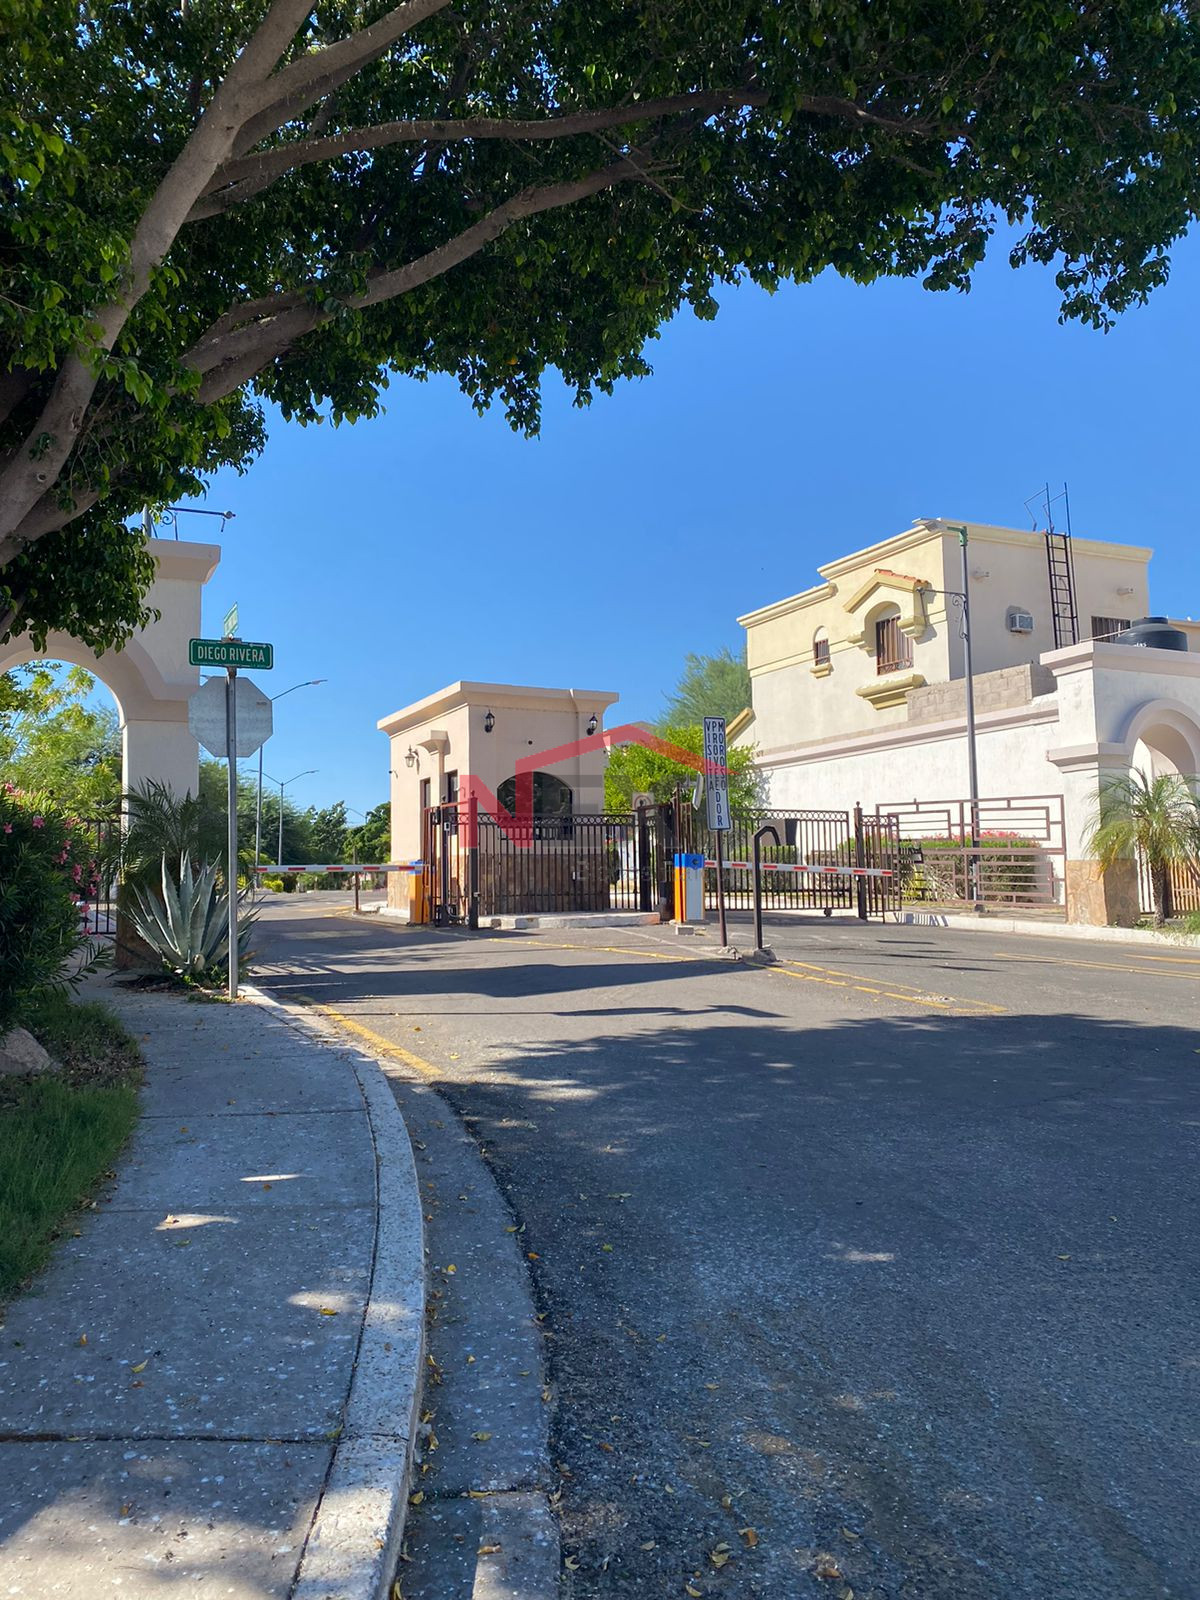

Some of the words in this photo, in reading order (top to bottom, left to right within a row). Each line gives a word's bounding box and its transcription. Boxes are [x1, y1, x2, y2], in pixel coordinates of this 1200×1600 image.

[198, 646, 227, 661] DIEGO
[229, 648, 265, 662] RIVERA
[706, 721, 715, 791] VISITA
[712, 721, 723, 826] PROVEEDOR
[718, 721, 726, 790] MOROSO
